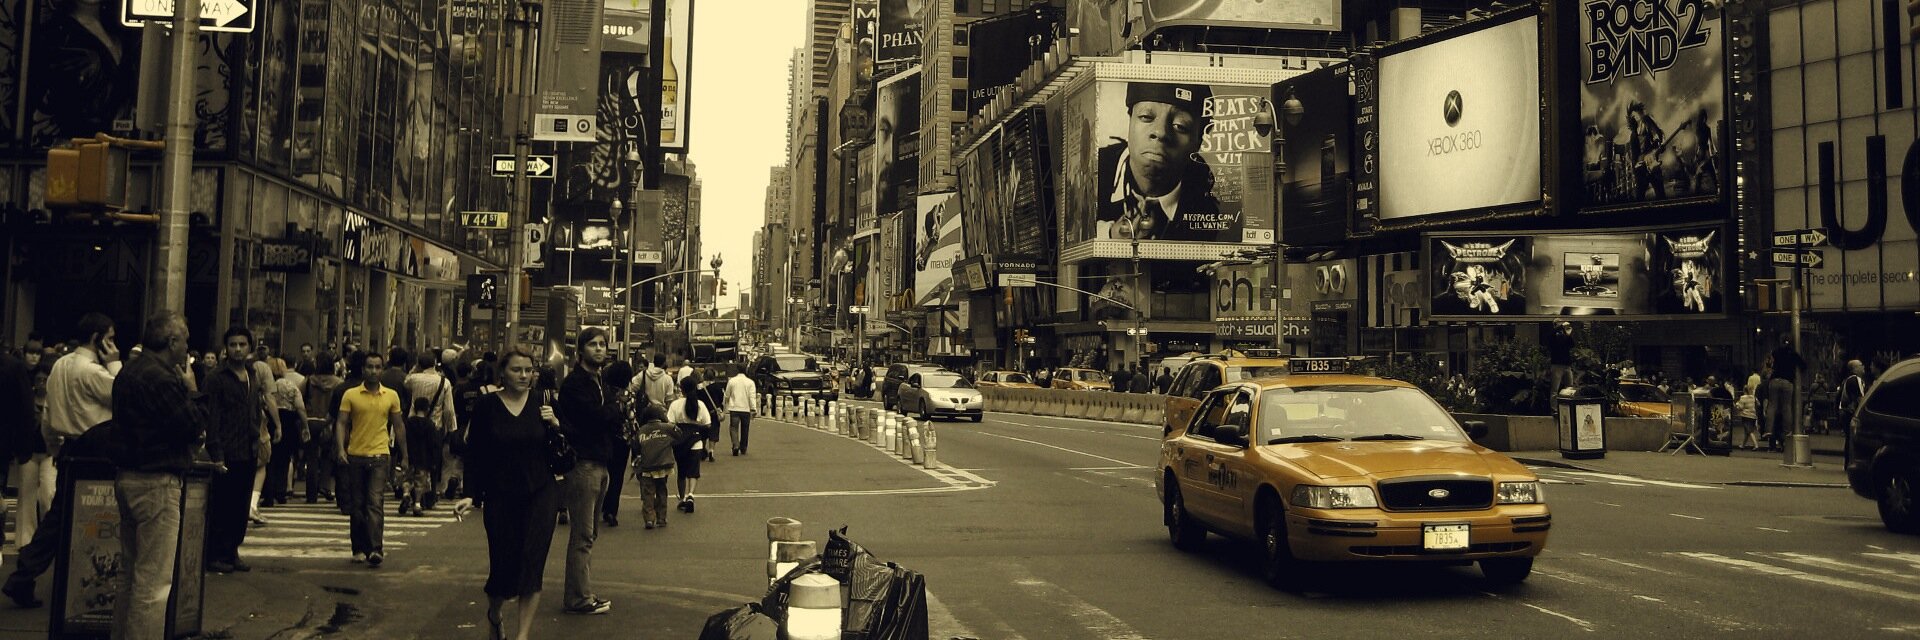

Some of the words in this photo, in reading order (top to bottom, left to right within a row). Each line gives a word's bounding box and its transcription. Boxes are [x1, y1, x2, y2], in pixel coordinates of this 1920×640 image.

[1585, 0, 1678, 44] ROCK
[1677, 0, 1711, 50] 2
[602, 26, 634, 36] SUNG
[1585, 27, 1678, 85] BAND
[1201, 97, 1258, 118] BEATS
[1210, 117, 1250, 132] THAT
[1200, 130, 1262, 152] STICK
[1428, 134, 1458, 157] XBOX
[1460, 130, 1482, 151] 360
[501, 163, 514, 171] ON
[461, 214, 469, 226] W
[473, 214, 488, 226] 44
[1780, 236, 1795, 244] ONE
[1804, 233, 1822, 243] WAY
[930, 258, 952, 269] maxell
[1778, 254, 1793, 262] ONE
[1245, 323, 1299, 336] swatch
[1306, 360, 1329, 371] 7B35
